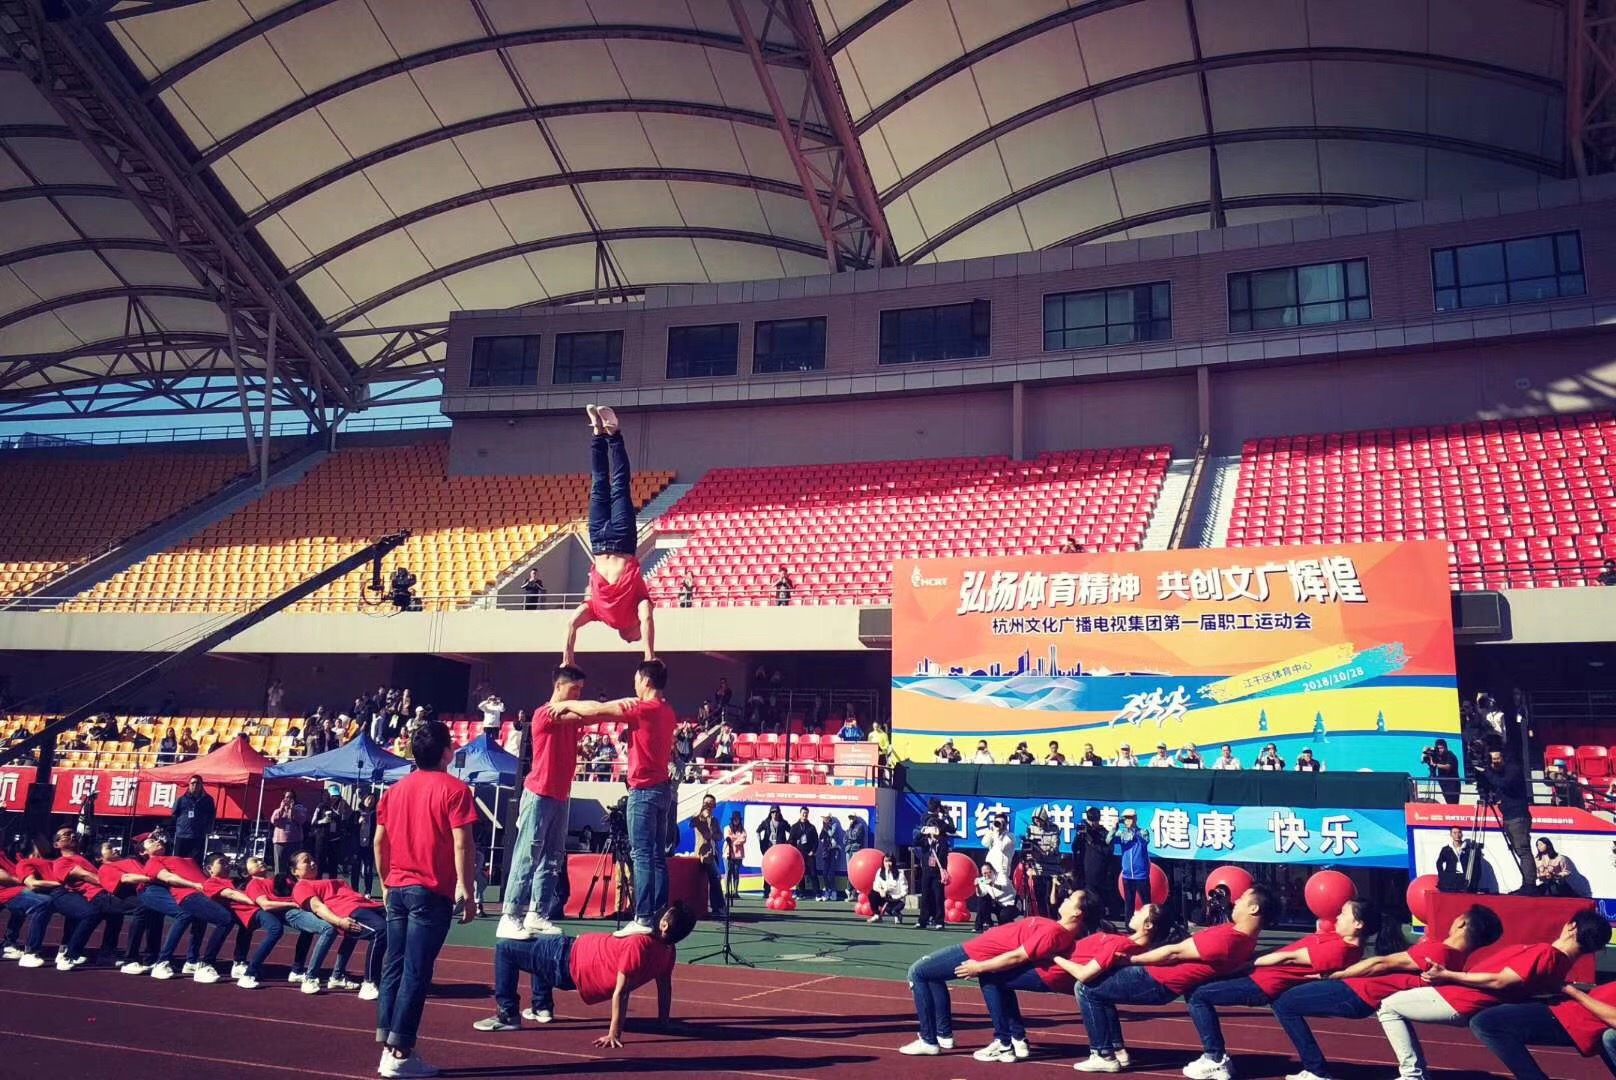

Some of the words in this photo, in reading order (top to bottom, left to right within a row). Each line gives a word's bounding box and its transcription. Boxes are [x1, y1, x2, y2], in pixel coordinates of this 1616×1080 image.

[957, 570, 1140, 615] 弘扬体育精神
[1157, 556, 1368, 604] 共创文广辉煌
[992, 612, 1312, 635] 杭州文化广播电视集团第一届职工运动会
[1302, 666, 1365, 693] 2018/10/28
[1151, 807, 1236, 850] 健康
[1268, 811, 1360, 855] 快乐
